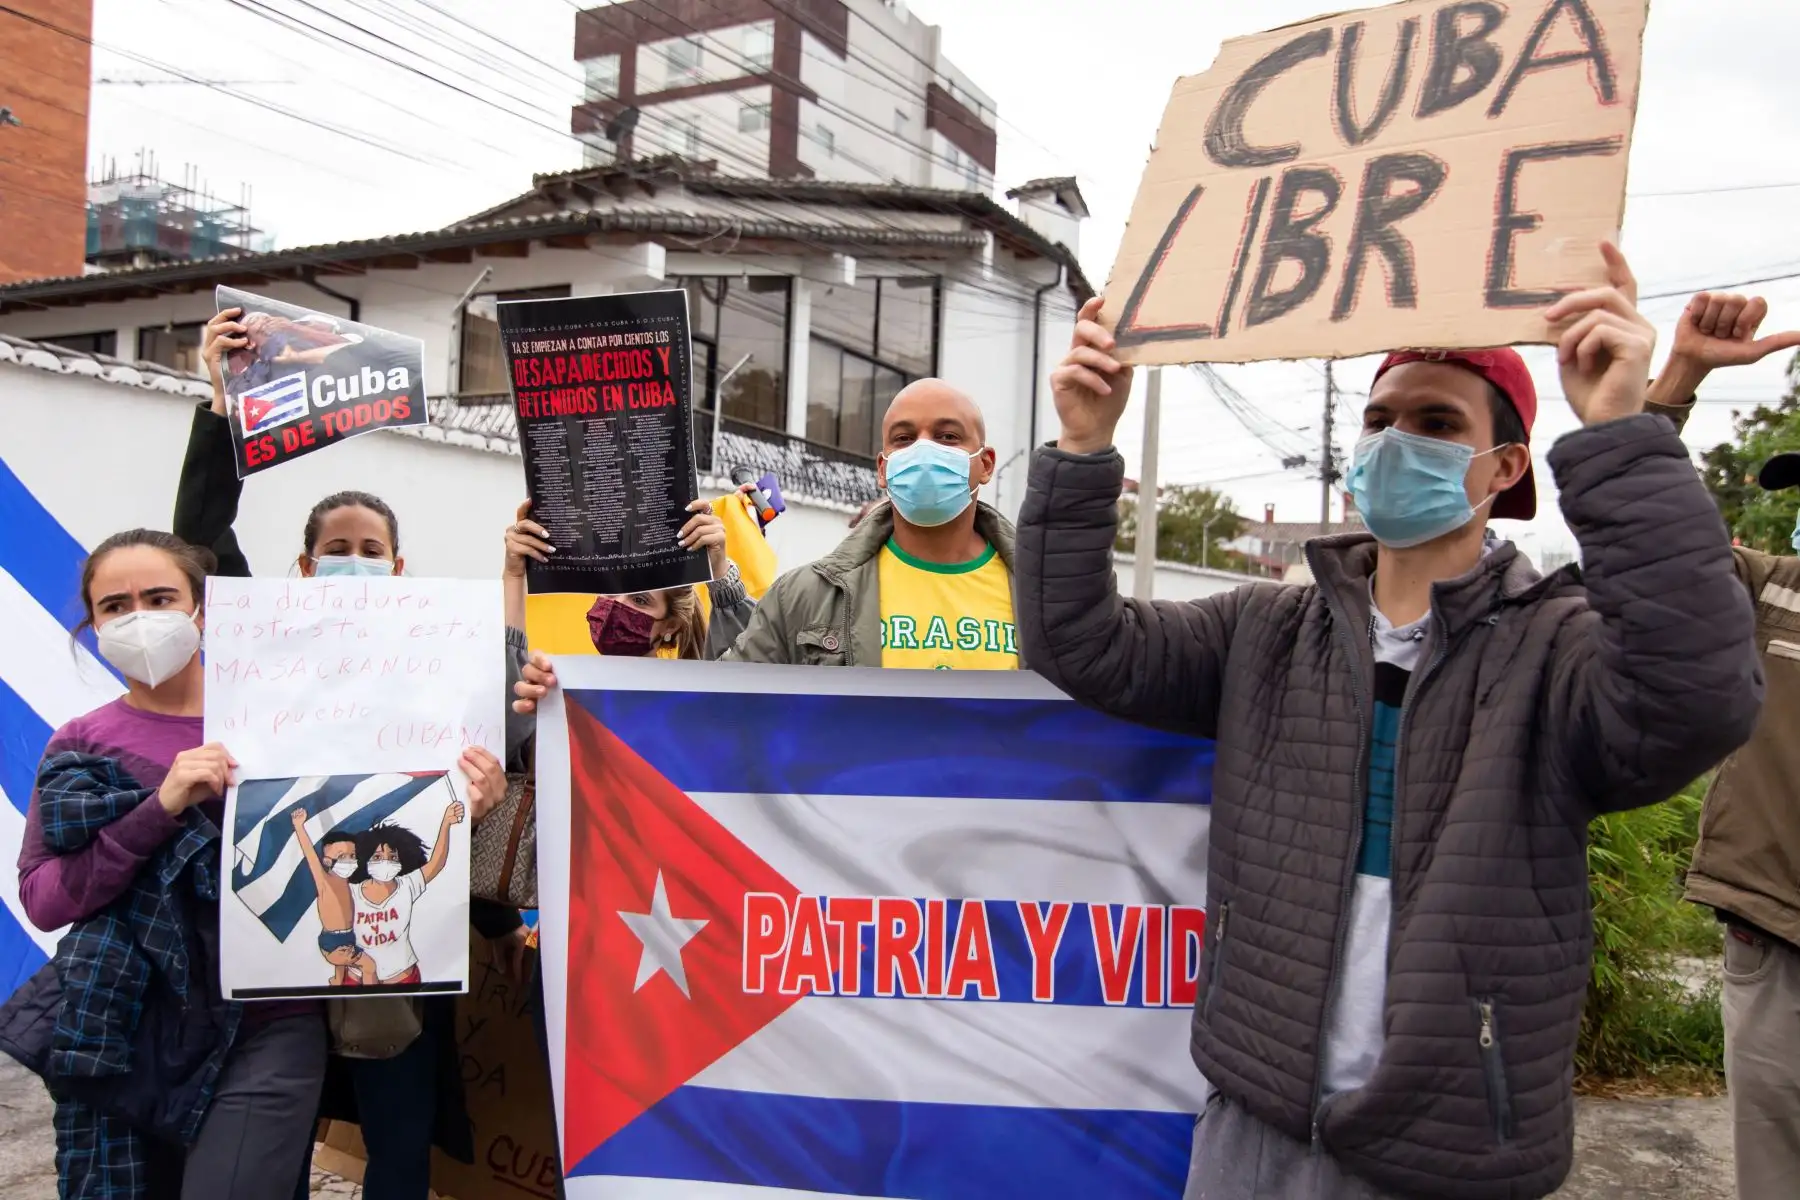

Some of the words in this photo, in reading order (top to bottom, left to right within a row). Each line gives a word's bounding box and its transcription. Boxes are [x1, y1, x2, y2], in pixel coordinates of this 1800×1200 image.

[1203, 0, 1618, 168] CUBA
[1114, 136, 1623, 348] LIBRE
[511, 341, 521, 354] YA
[521, 341, 531, 354] SE
[531, 339, 568, 354] EMPIEZAN
[569, 338, 576, 350] A
[577, 334, 608, 350] CONTAR
[608, 334, 623, 347] POR
[624, 331, 654, 346] CIENTOS
[655, 330, 670, 343] LOS
[514, 349, 654, 388] DESAPARECIDOS
[656, 346, 672, 376] Y
[310, 366, 410, 409] Cuba
[517, 386, 597, 418] DETENIDOS
[603, 384, 625, 411] EN
[627, 379, 677, 410] CUBA
[244, 435, 277, 468] ES
[282, 419, 316, 455] DE
[320, 394, 412, 438] TODOS
[206, 580, 251, 610] La
[276, 581, 434, 610] dictadura
[880, 615, 1018, 655] RASIL
[272, 700, 371, 735] pueblo
[357, 907, 399, 924] PATRIA
[371, 924, 379, 934] Y
[362, 930, 397, 946] VIDA
[742, 891, 1001, 1001] PATRIA
[1015, 900, 1073, 1003] Y
[1087, 901, 1206, 1008] VID
